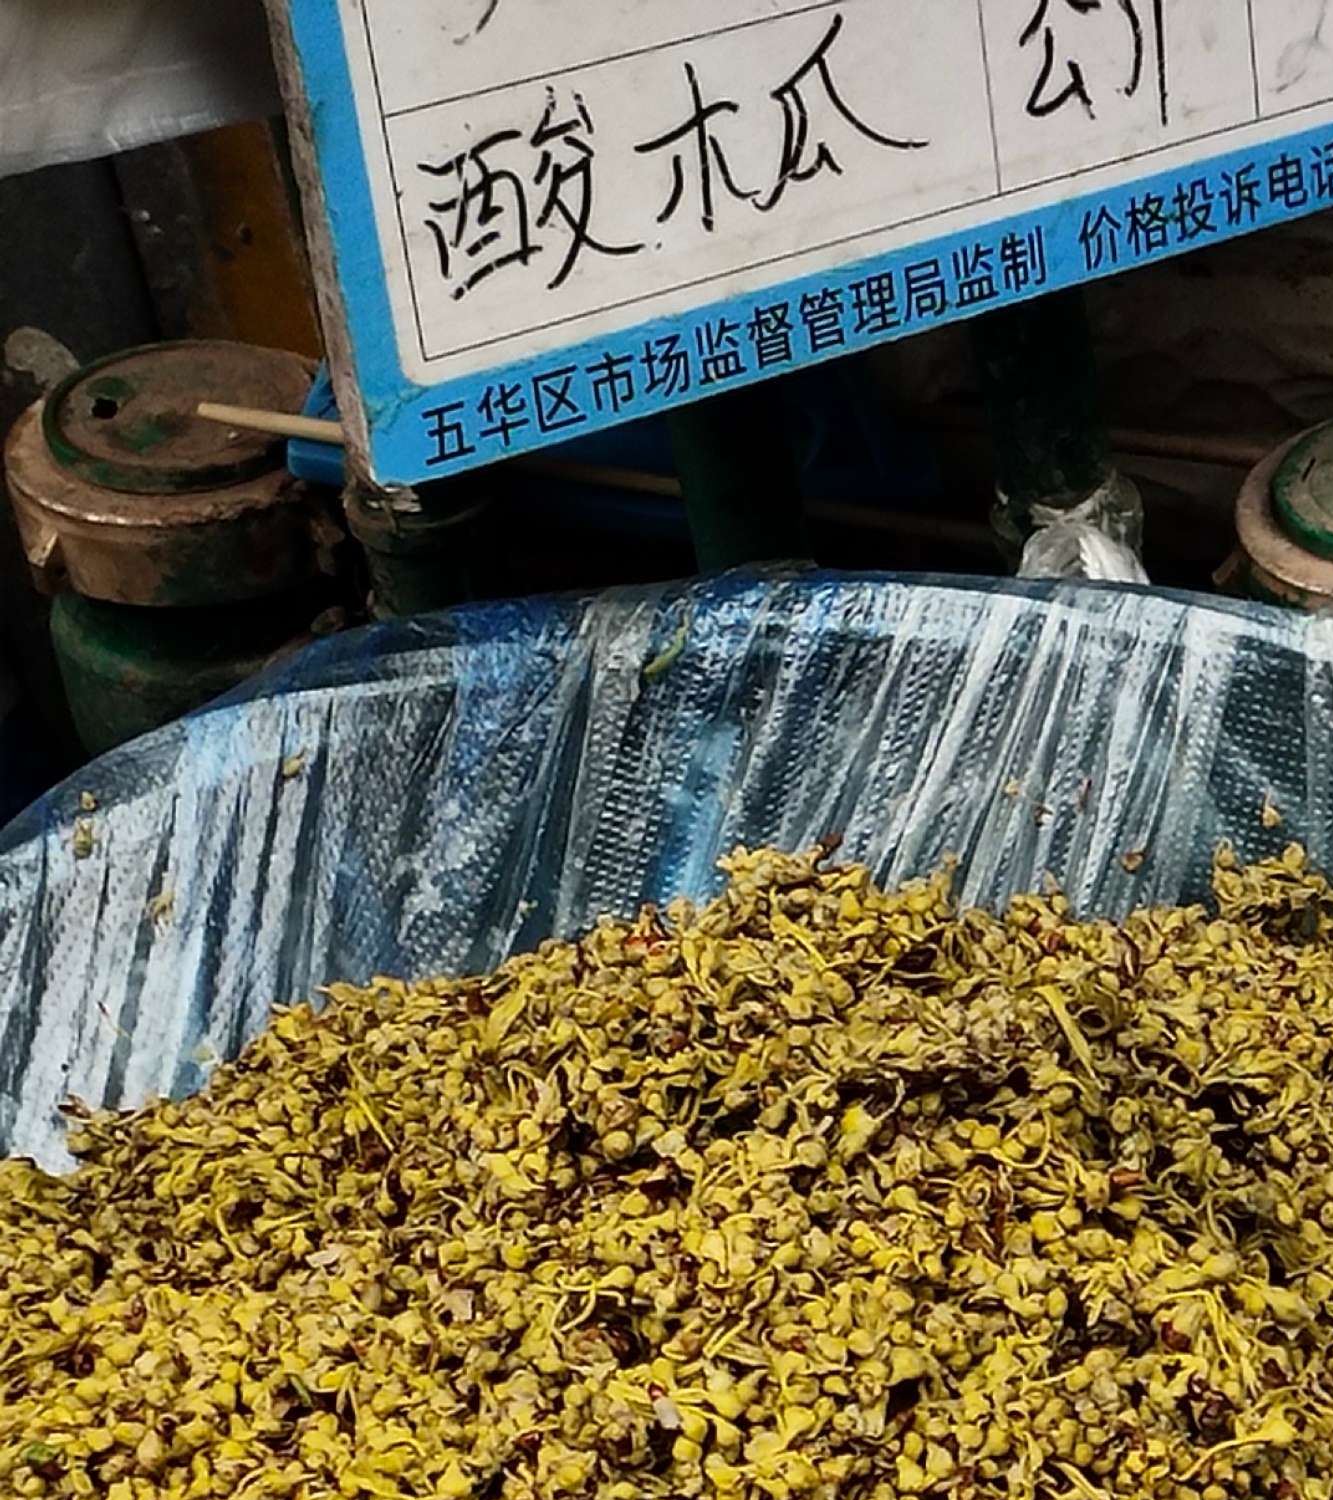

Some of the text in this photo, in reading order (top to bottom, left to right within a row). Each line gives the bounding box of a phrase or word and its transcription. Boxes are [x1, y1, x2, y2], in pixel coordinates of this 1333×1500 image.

[417, 14, 929, 300] 酸木瓜
[422, 226, 1046, 467] 五华区市场监督管理局监制
